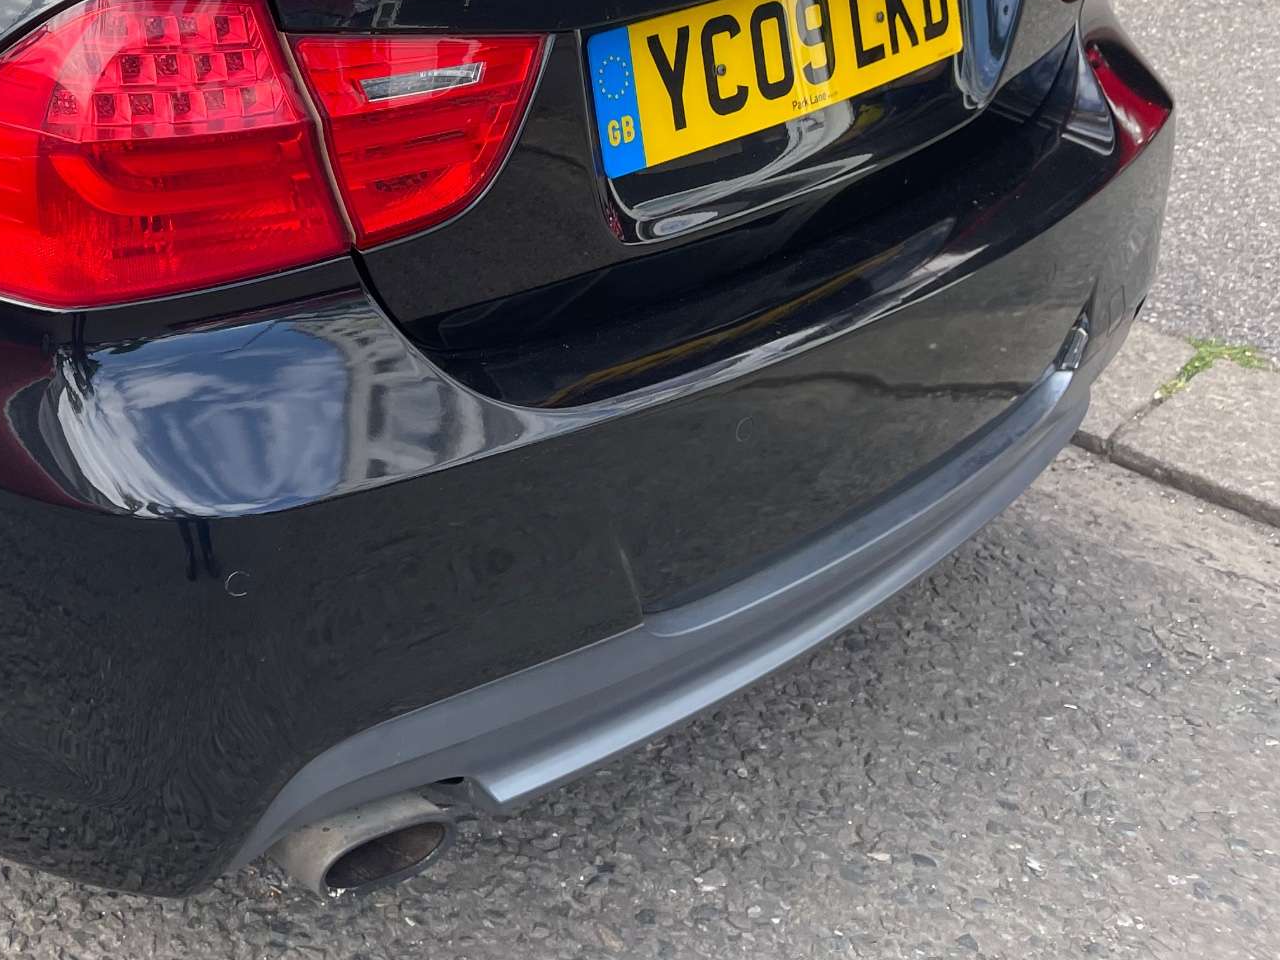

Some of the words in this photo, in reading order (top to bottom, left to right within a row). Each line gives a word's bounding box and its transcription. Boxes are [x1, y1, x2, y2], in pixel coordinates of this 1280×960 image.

[791, 97, 809, 112] Park
[809, 93, 828, 106] Lane
[606, 114, 636, 148] GB
